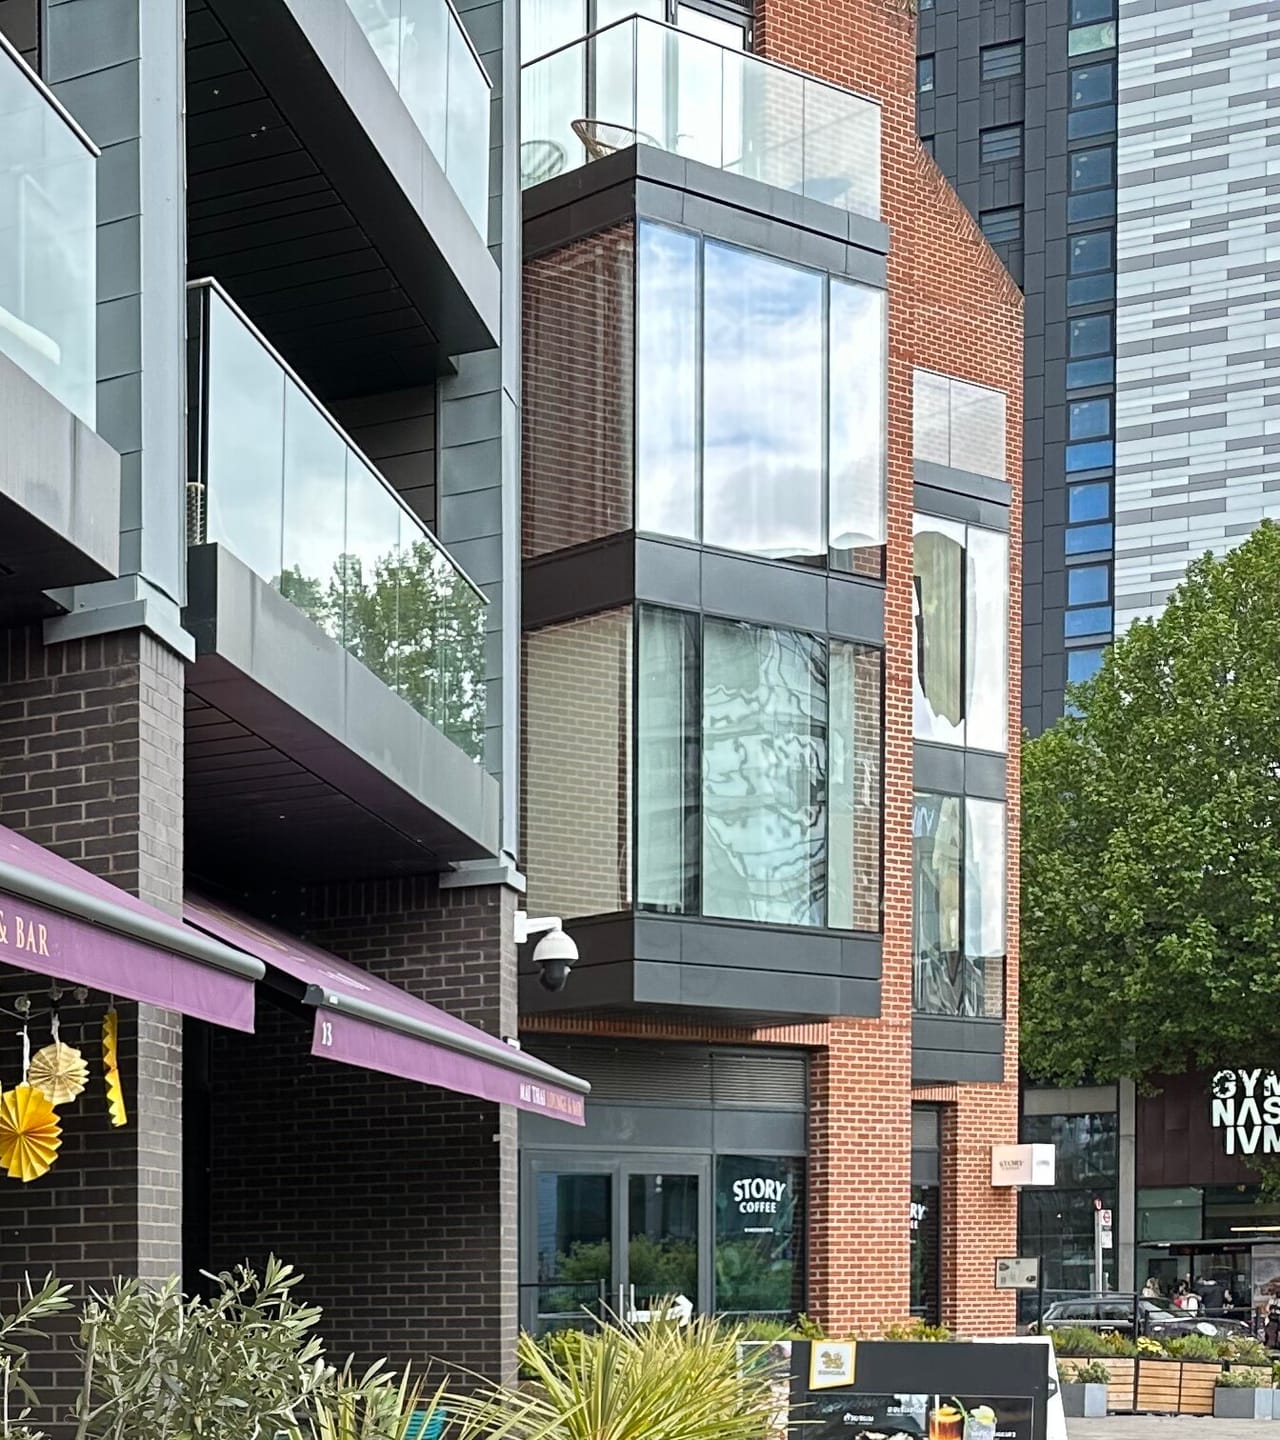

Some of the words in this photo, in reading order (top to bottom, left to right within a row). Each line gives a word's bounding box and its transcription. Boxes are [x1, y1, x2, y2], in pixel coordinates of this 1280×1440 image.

[16, 916, 50, 957] BAR
[321, 1022, 333, 1046] 13
[732, 1177, 787, 1201] STORY
[739, 1201, 777, 1213] COFFEE
